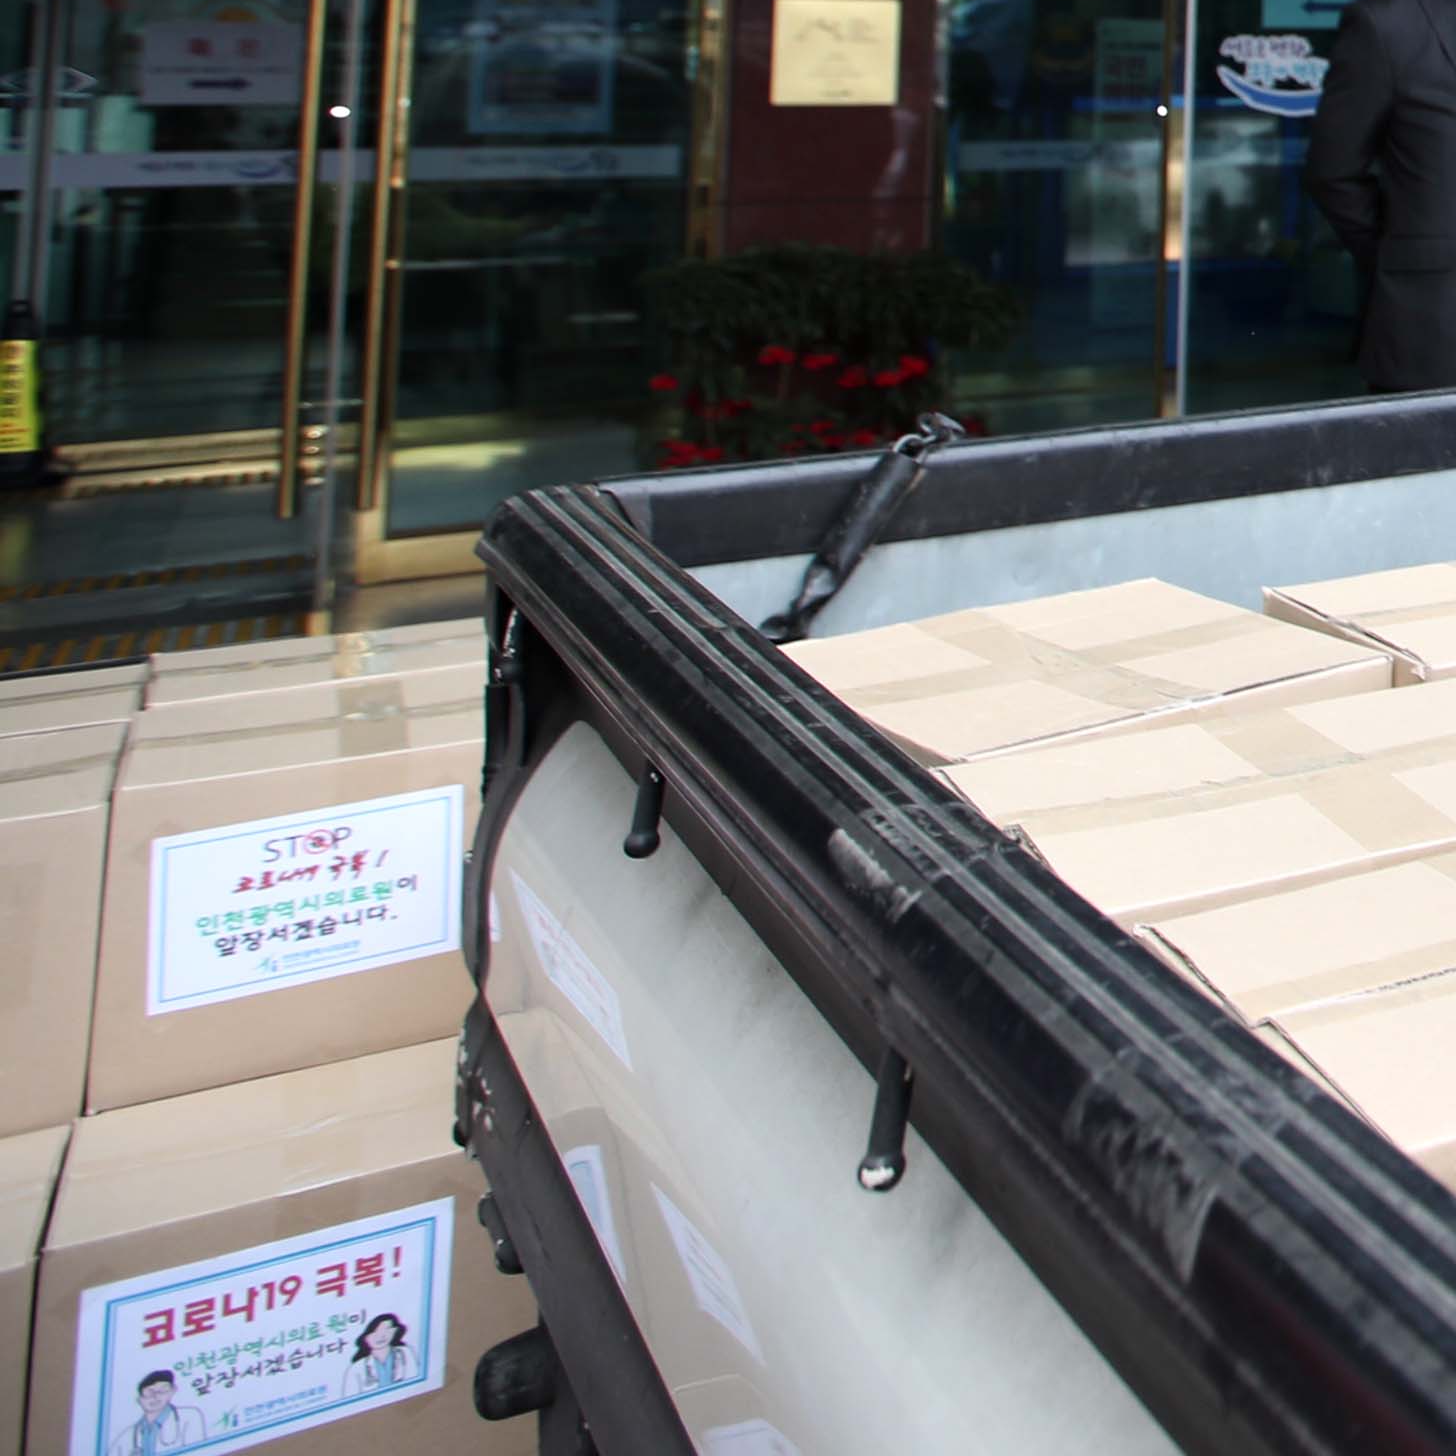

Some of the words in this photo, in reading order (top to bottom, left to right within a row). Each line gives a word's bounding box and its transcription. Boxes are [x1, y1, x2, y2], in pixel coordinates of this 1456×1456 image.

[262, 826, 352, 864] STOP
[194, 875, 418, 937] 인천광역시의료원이
[214, 904, 399, 958] 앞장서겠습니다.
[141, 1274, 304, 1348] 코로나19
[315, 1246, 403, 1298] 극복!
[189, 1340, 350, 1399] 앞장서겠습니다
